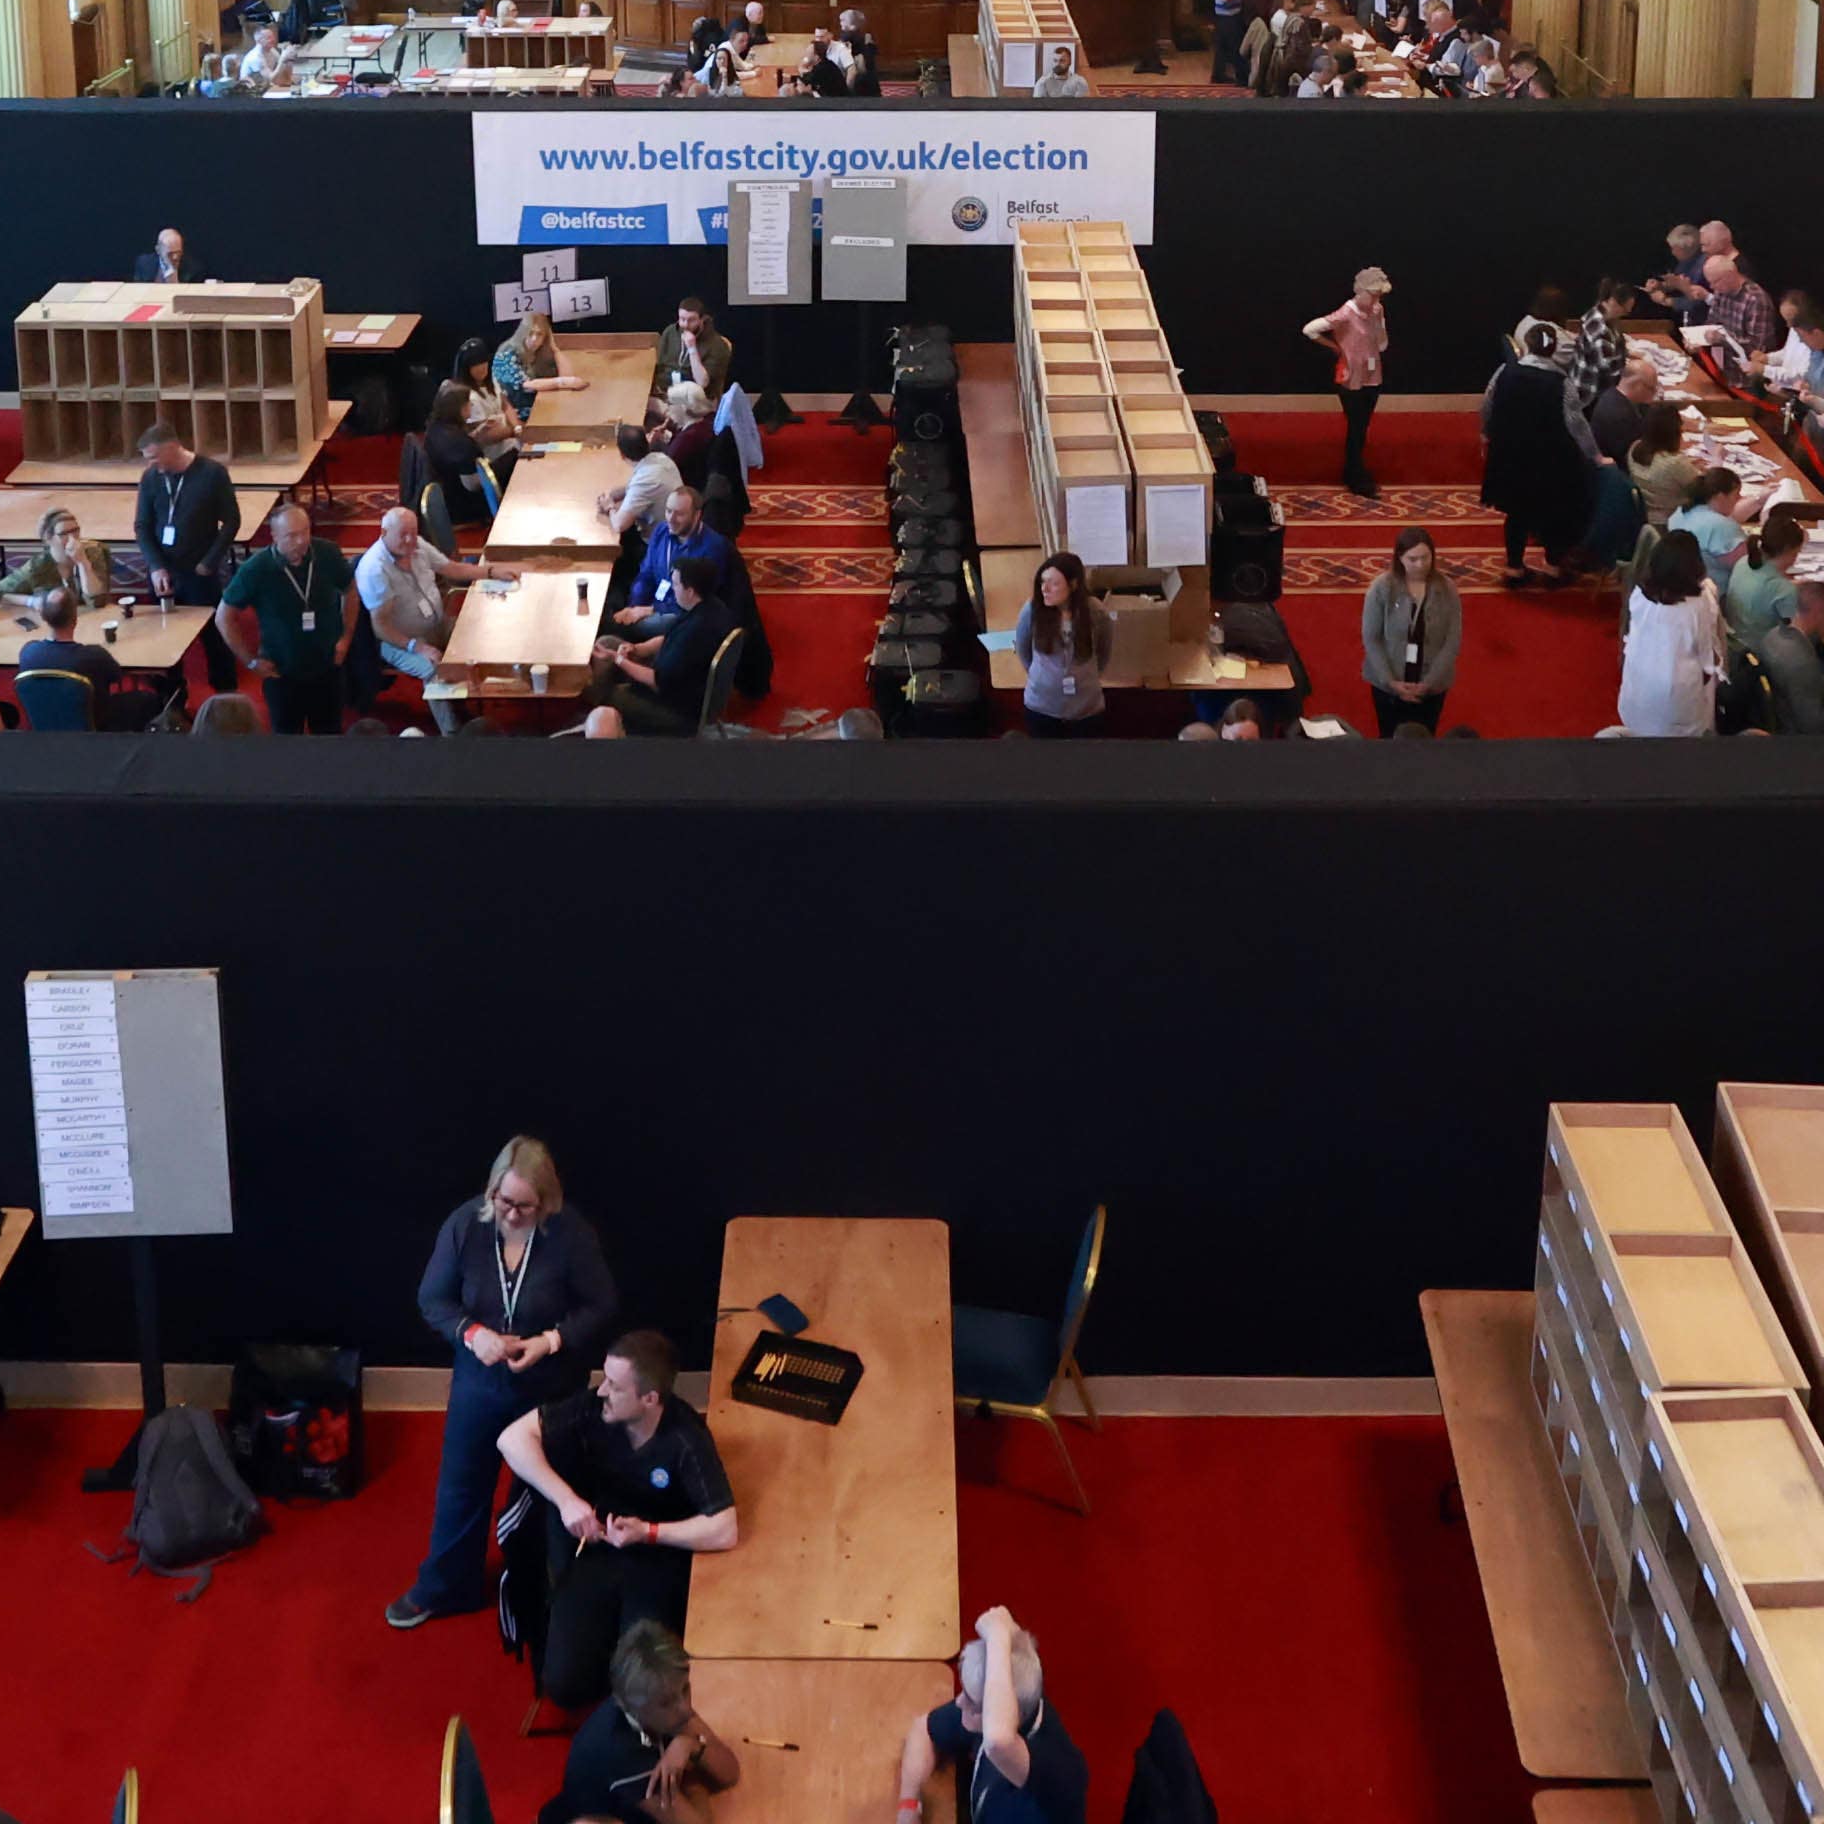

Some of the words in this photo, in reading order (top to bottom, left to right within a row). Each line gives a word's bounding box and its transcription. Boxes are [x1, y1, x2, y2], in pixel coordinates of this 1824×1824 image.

[539, 141, 1088, 178] www.belfastcity.gov.uk/election
[1007, 200, 1060, 214] Belfast
[541, 212, 646, 230] @belfastcc
[540, 265, 560, 283] 11
[512, 296, 534, 313] 12
[569, 296, 593, 313] 13
